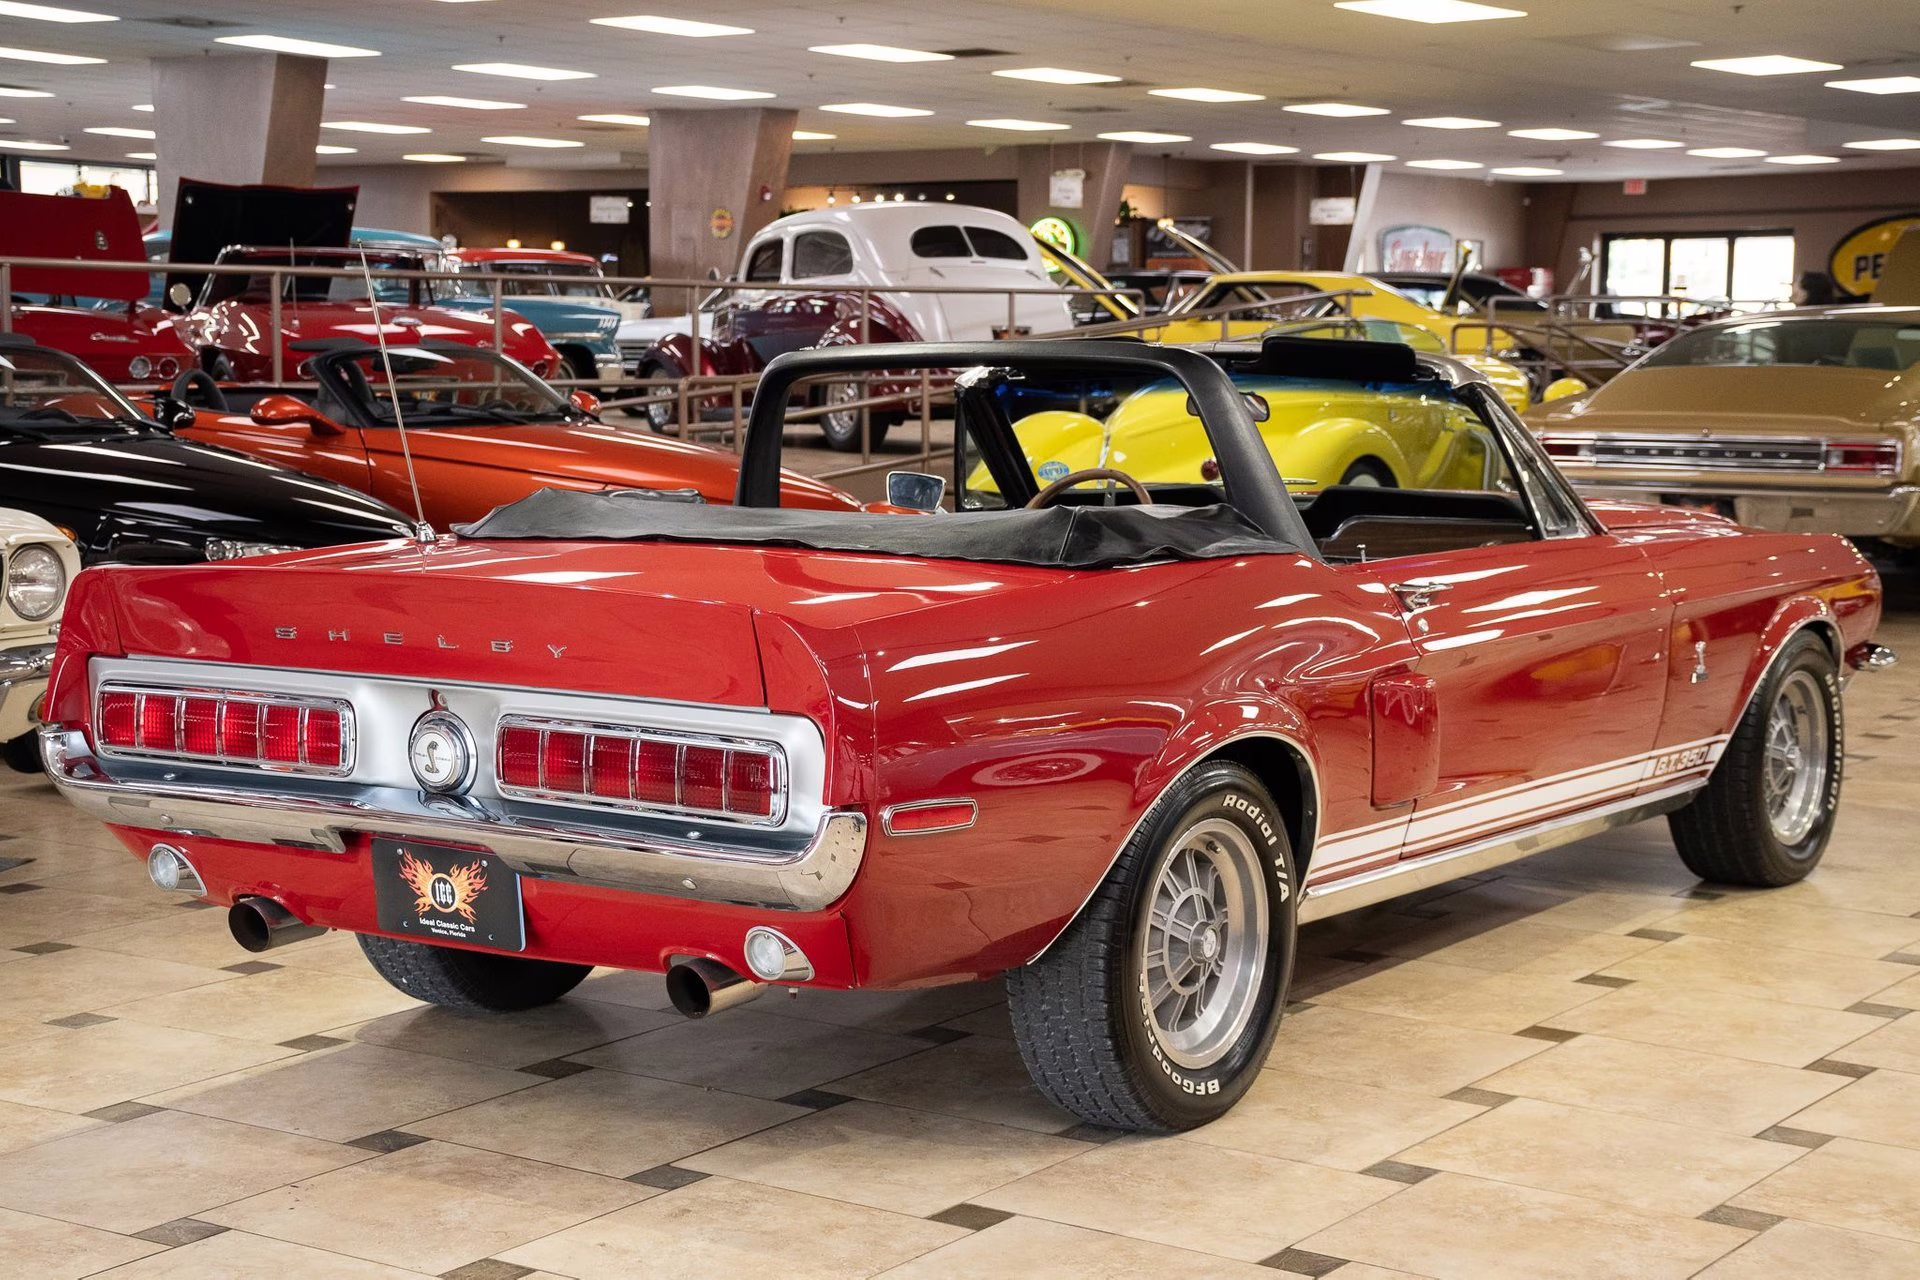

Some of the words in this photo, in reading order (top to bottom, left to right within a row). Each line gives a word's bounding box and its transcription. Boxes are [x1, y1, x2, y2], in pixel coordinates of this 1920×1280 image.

[1623, 448, 1790, 459] MERCURY
[275, 626, 568, 659] SHELBY
[1222, 794, 1278, 846] Radial
[1274, 852, 1290, 903] T/A
[434, 880, 453, 905] ICC
[419, 917, 436, 926] Ideal
[436, 919, 460, 930] Classic
[460, 923, 476, 932] Cars
[449, 930, 467, 938] Florida
